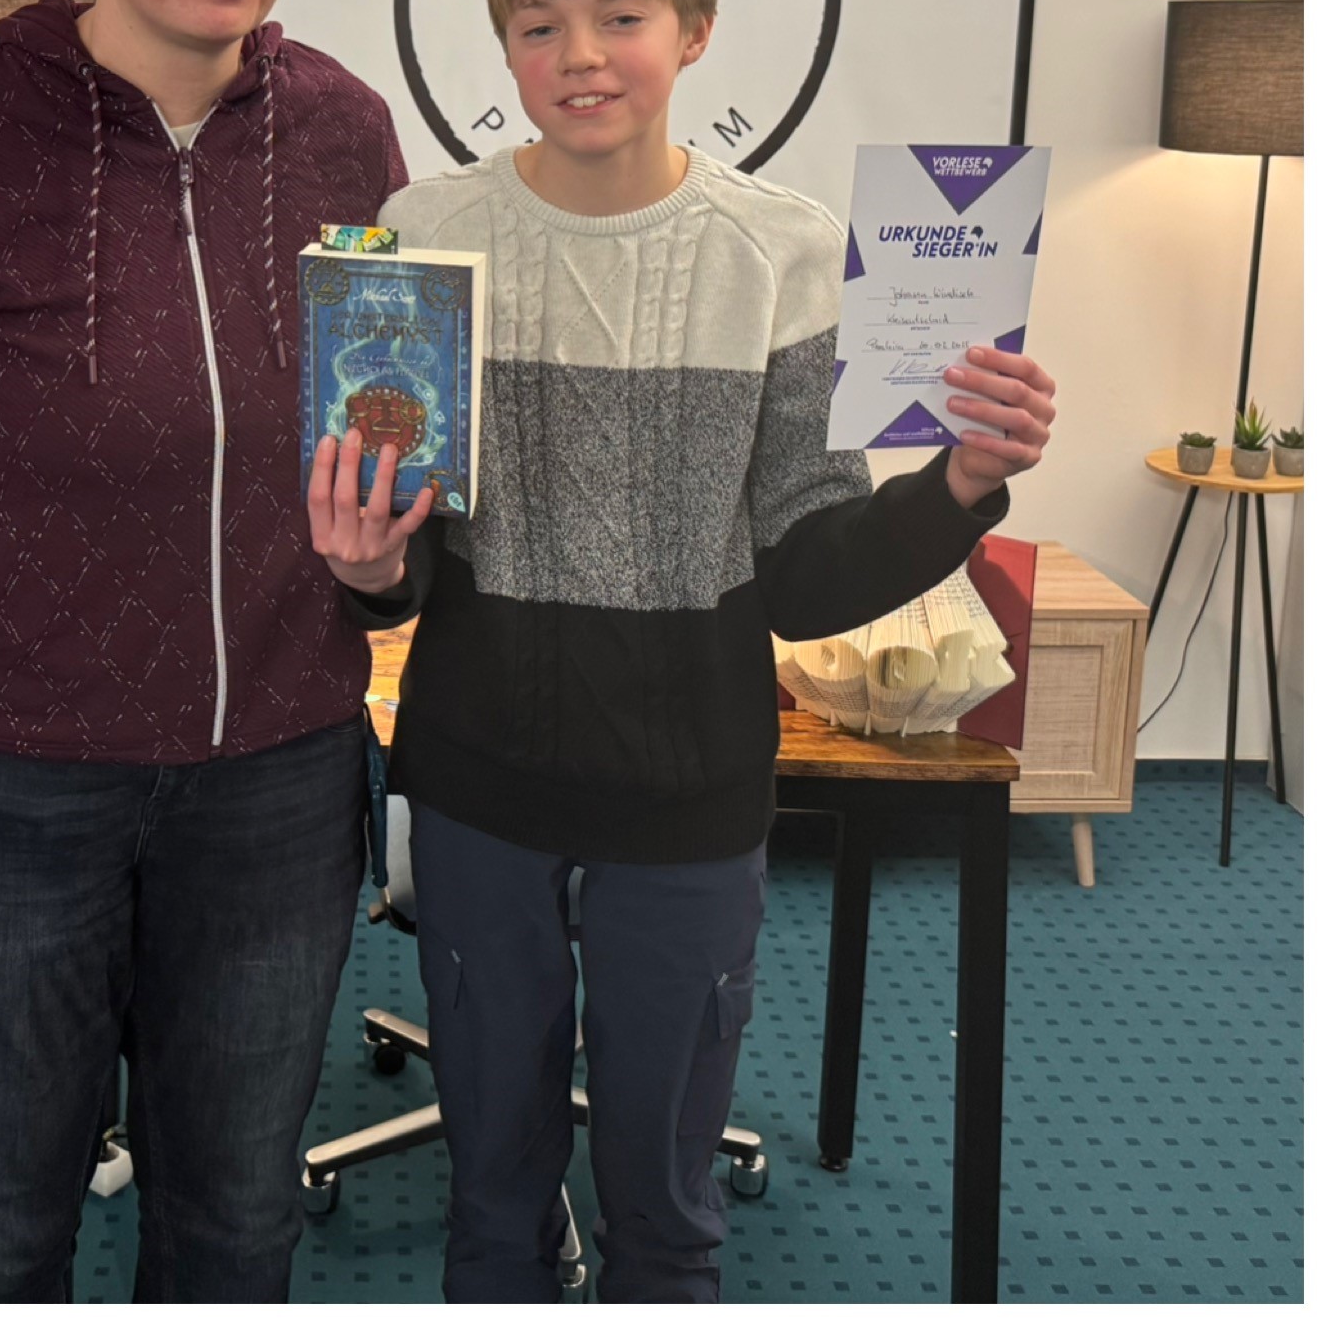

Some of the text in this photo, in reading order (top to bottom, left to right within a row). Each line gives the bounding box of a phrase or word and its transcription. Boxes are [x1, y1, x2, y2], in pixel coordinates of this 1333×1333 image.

[933, 156, 981, 169] VORLESE
[934, 167, 988, 177] WETTBEWERB
[878, 225, 968, 243] URKUNDE
